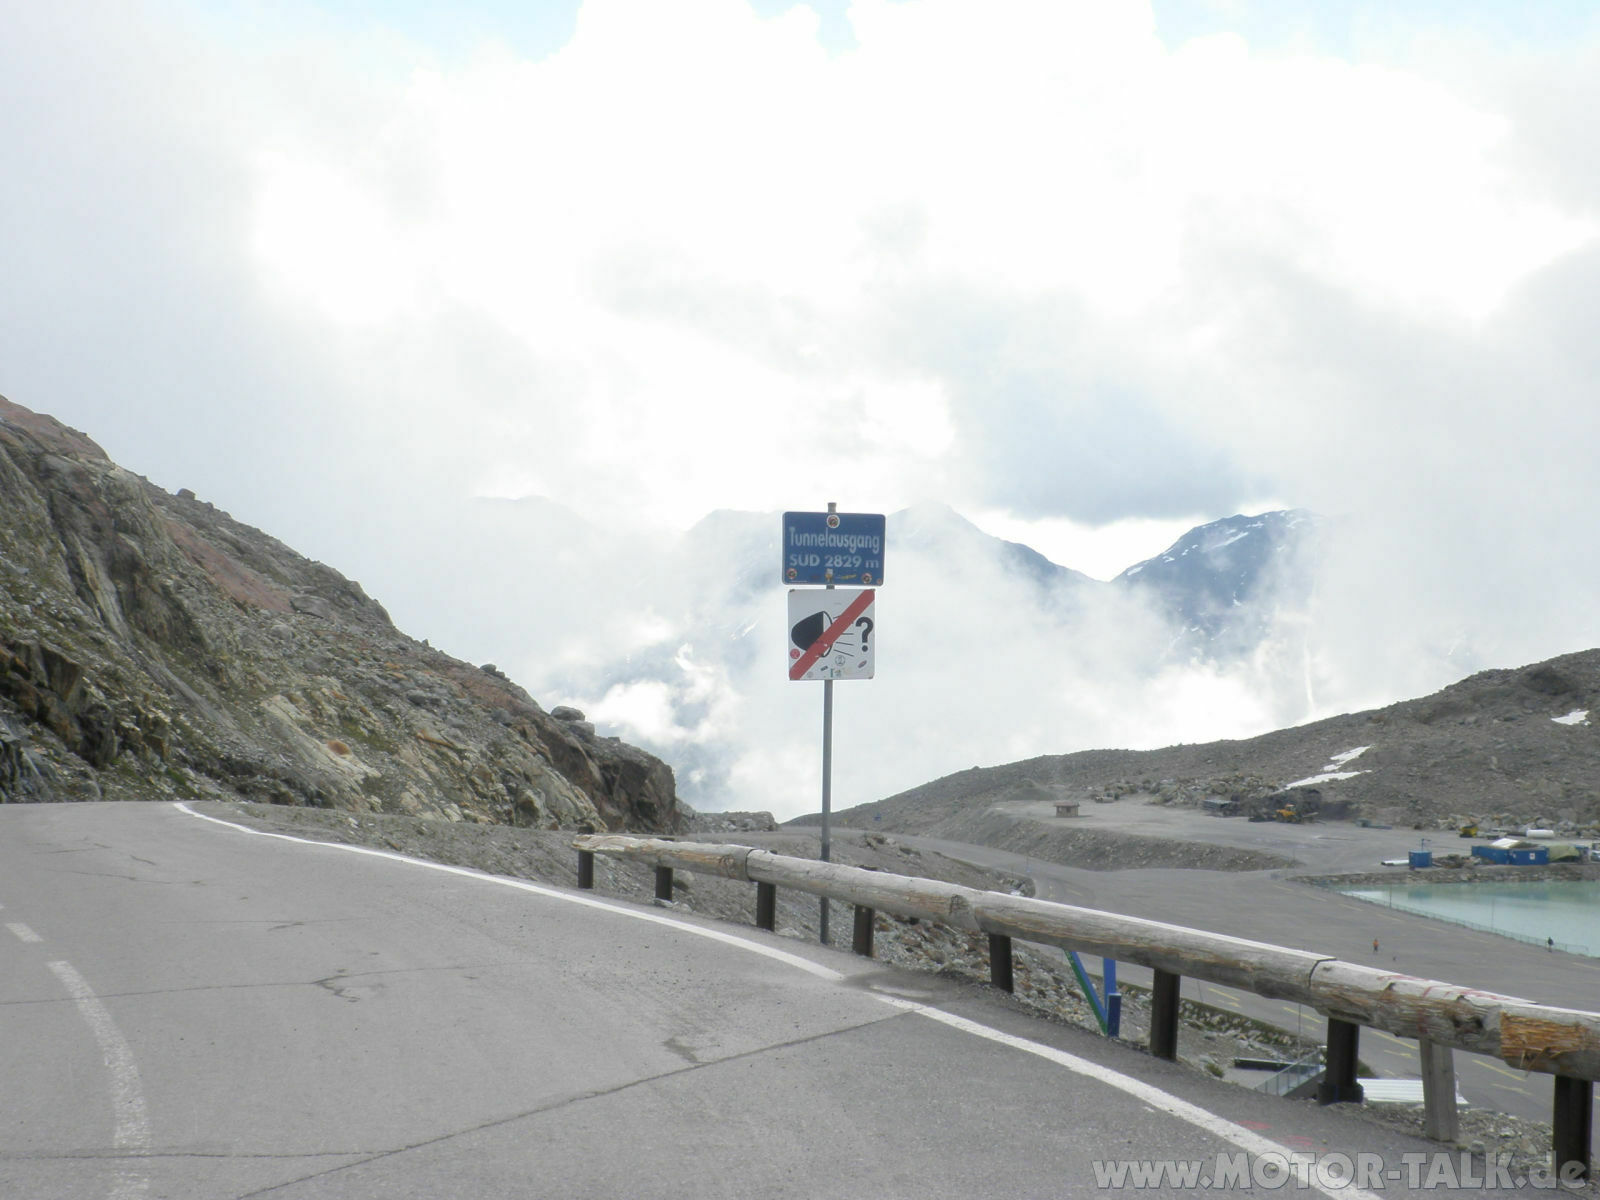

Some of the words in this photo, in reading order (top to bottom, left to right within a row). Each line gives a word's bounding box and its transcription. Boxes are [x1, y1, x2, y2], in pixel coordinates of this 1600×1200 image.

[789, 528, 880, 554] Tunnelausgang
[824, 554, 862, 568] 2829
[864, 559, 879, 568] m
